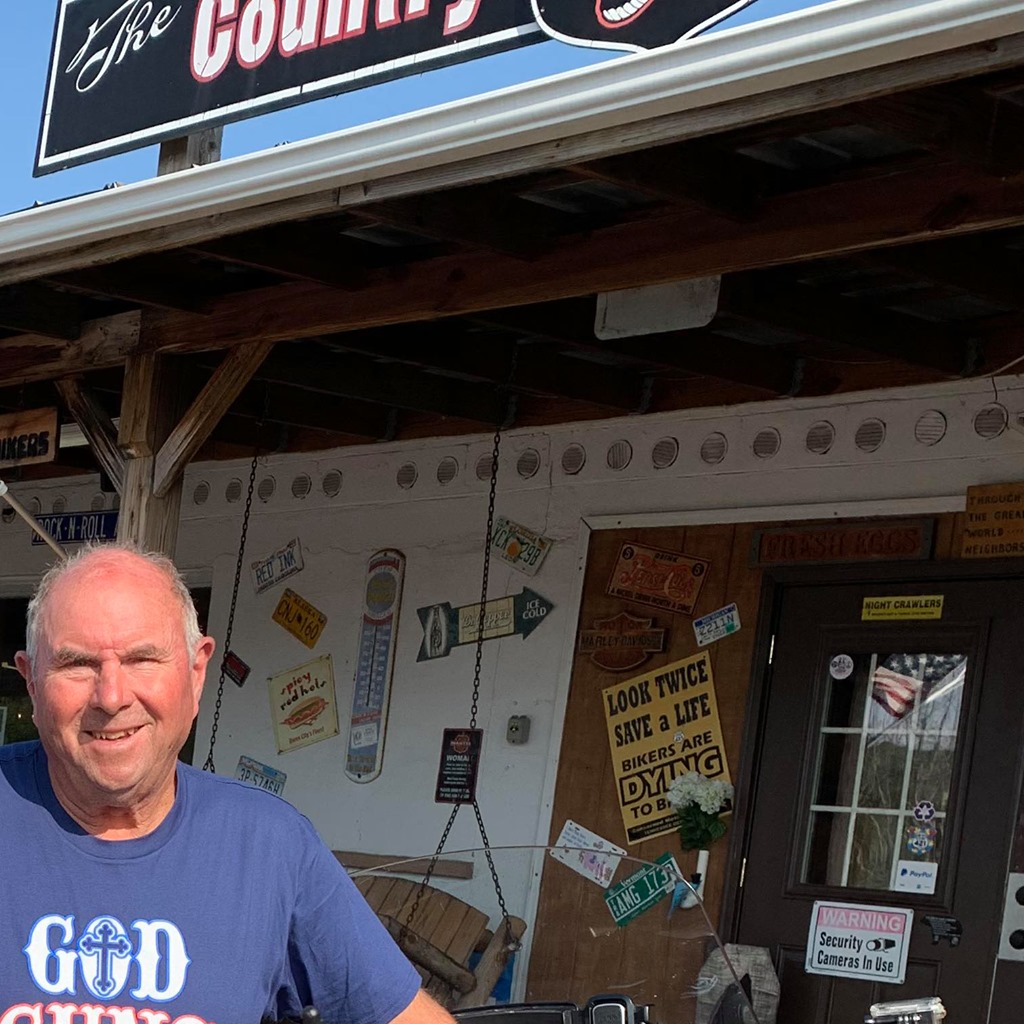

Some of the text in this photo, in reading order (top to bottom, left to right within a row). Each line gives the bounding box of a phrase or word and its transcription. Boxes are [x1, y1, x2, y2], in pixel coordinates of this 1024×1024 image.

[66, 0, 480, 92] The Coun
[522, 607, 547, 620] COLD
[526, 599, 540, 610] ICE
[865, 599, 942, 610] NIGHT CRAWLERS
[280, 672, 311, 695] spicy
[607, 659, 709, 717] LOOK TWICE
[280, 689, 299, 711] red
[614, 693, 711, 748] SAVE a LIFE
[621, 731, 713, 772] BIKERS ARE
[619, 746, 724, 806] DYING
[631, 801, 653, 819] TO
[909, 870, 933, 878] PayPal
[821, 909, 902, 932] WARNING
[819, 931, 864, 953] Security
[22, 913, 192, 1003] GOD
[817, 950, 894, 973] Cameras In Use
